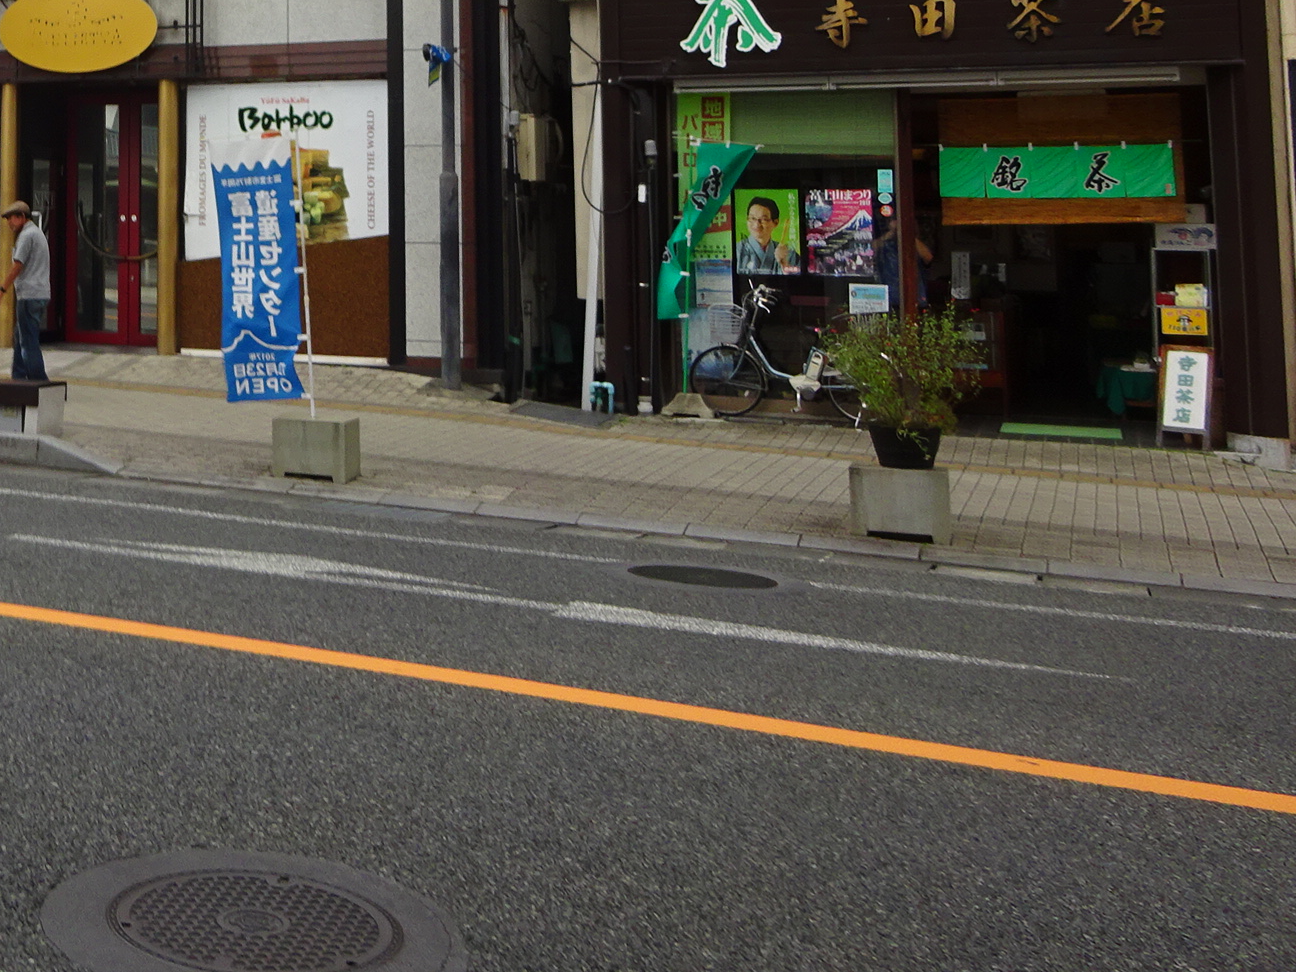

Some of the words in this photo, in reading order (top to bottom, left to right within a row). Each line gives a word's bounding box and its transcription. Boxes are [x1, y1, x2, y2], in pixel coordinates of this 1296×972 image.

[366, 109, 376, 149] WORLD
[198, 154, 207, 170] DU
[366, 150, 376, 172] THE
[198, 171, 207, 227] FROMAGES
[366, 174, 376, 189] OF
[366, 190, 376, 230] CHEESE
[1172, 355, 1198, 424] 寺田茶店
